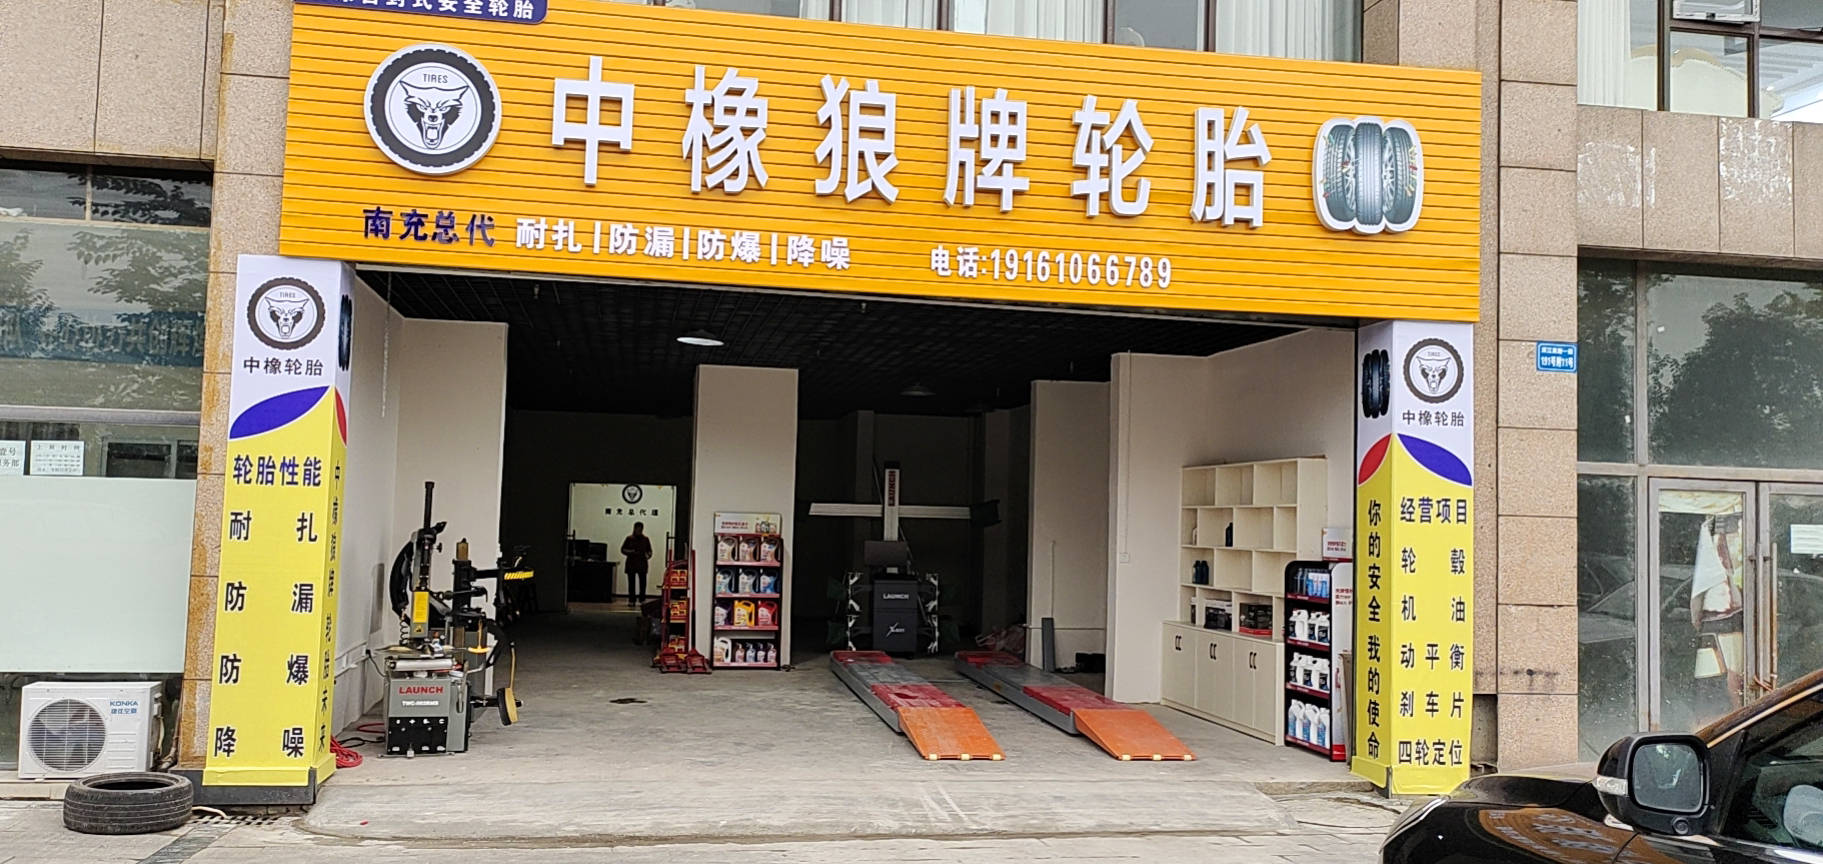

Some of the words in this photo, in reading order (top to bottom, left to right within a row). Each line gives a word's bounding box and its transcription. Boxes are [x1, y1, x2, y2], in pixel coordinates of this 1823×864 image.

[422, 73, 448, 85] TIRES
[552, 55, 1272, 229] 中橡狼牌轮胎
[363, 206, 495, 248] 南充总代
[930, 244, 1172, 289] 电话:19161066789
[243, 356, 324, 376] 中橡轮胎
[1402, 409, 1465, 427] 中橡轮胎
[233, 455, 322, 487] 轮胎性能
[1400, 496, 1467, 525] 经营项目
[399, 686, 444, 695] LAUNCH
[1398, 738, 1464, 767] 四轮定位
